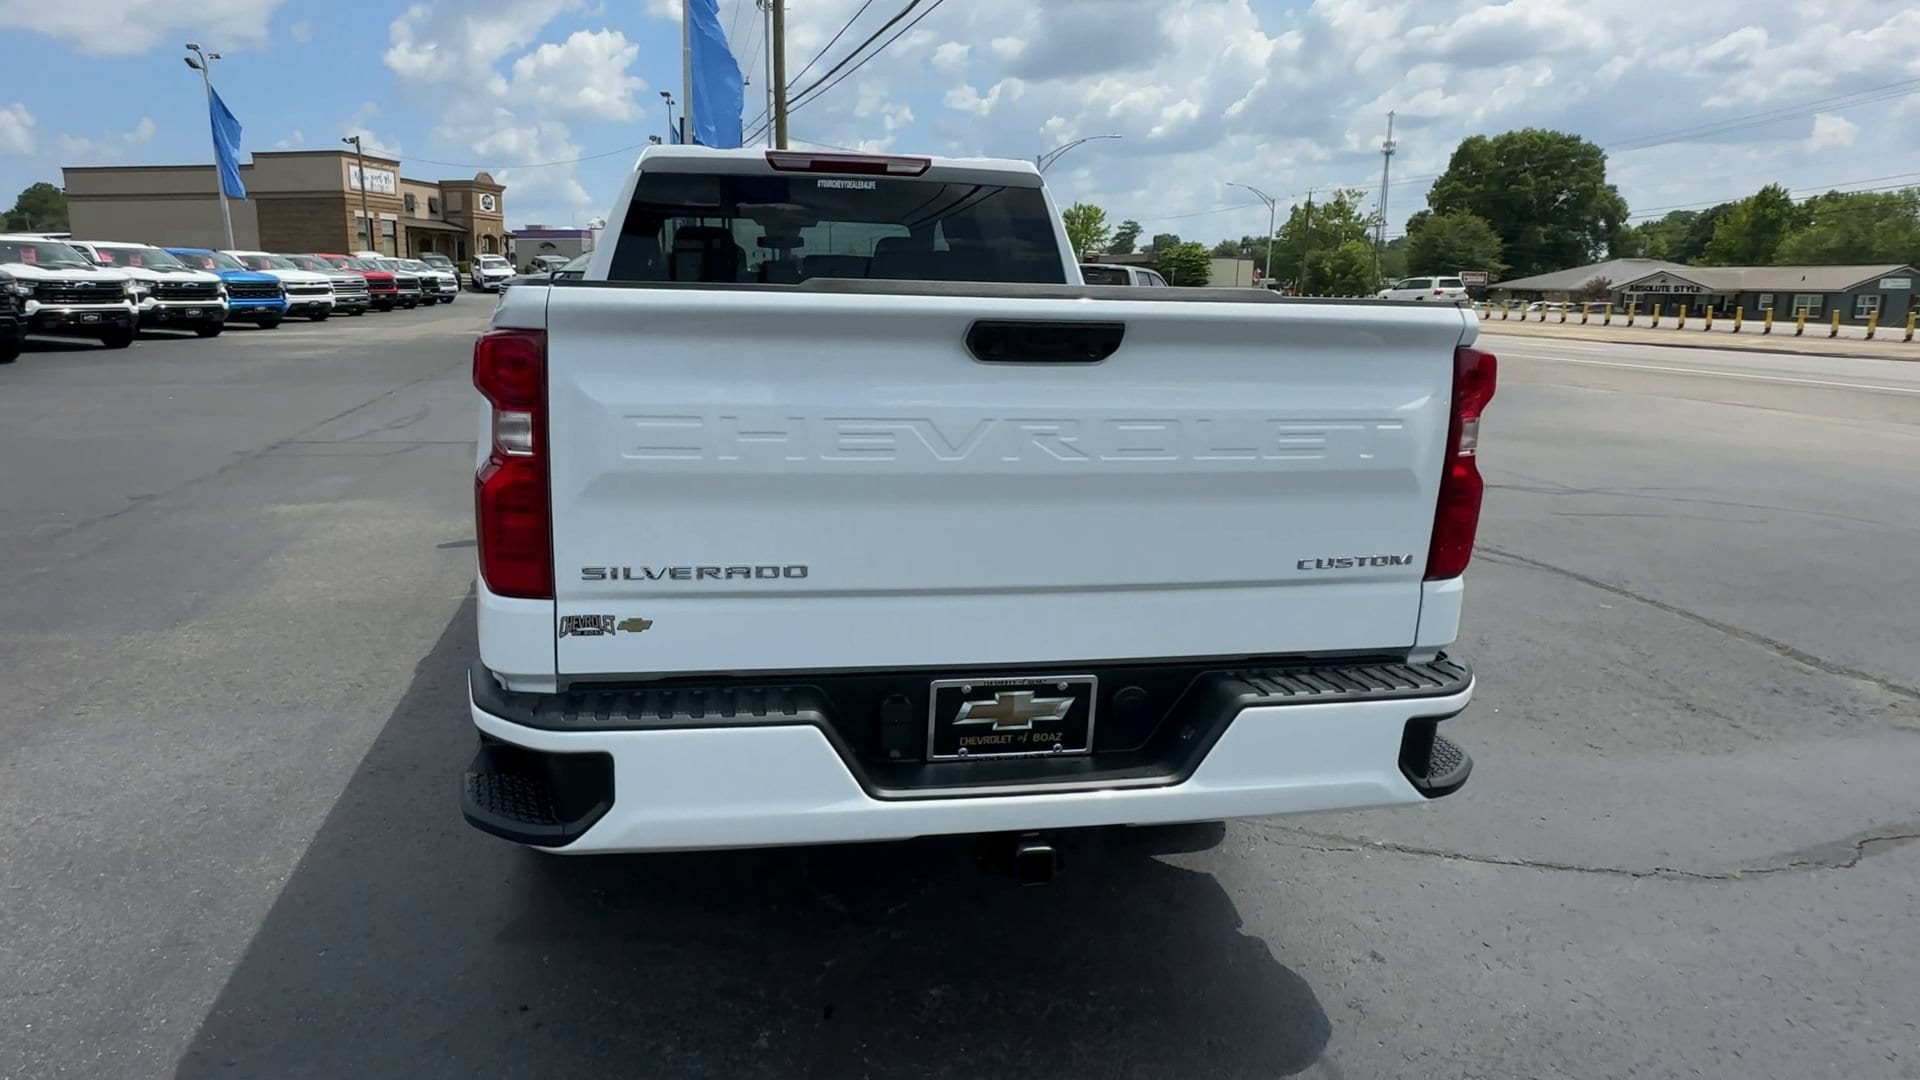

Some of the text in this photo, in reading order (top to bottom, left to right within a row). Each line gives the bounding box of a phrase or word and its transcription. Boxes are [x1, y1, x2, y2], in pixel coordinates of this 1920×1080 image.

[1629, 284, 1701, 293] ABSOLUTE STYLE
[621, 414, 1404, 462] CHEVROLET
[1297, 554, 1413, 570] CUSTOM
[581, 565, 808, 580] SILVERADO
[559, 614, 616, 639] CHEVROLET
[959, 734, 1013, 746] CHEVROLET
[1033, 732, 1063, 742] BOAZ
